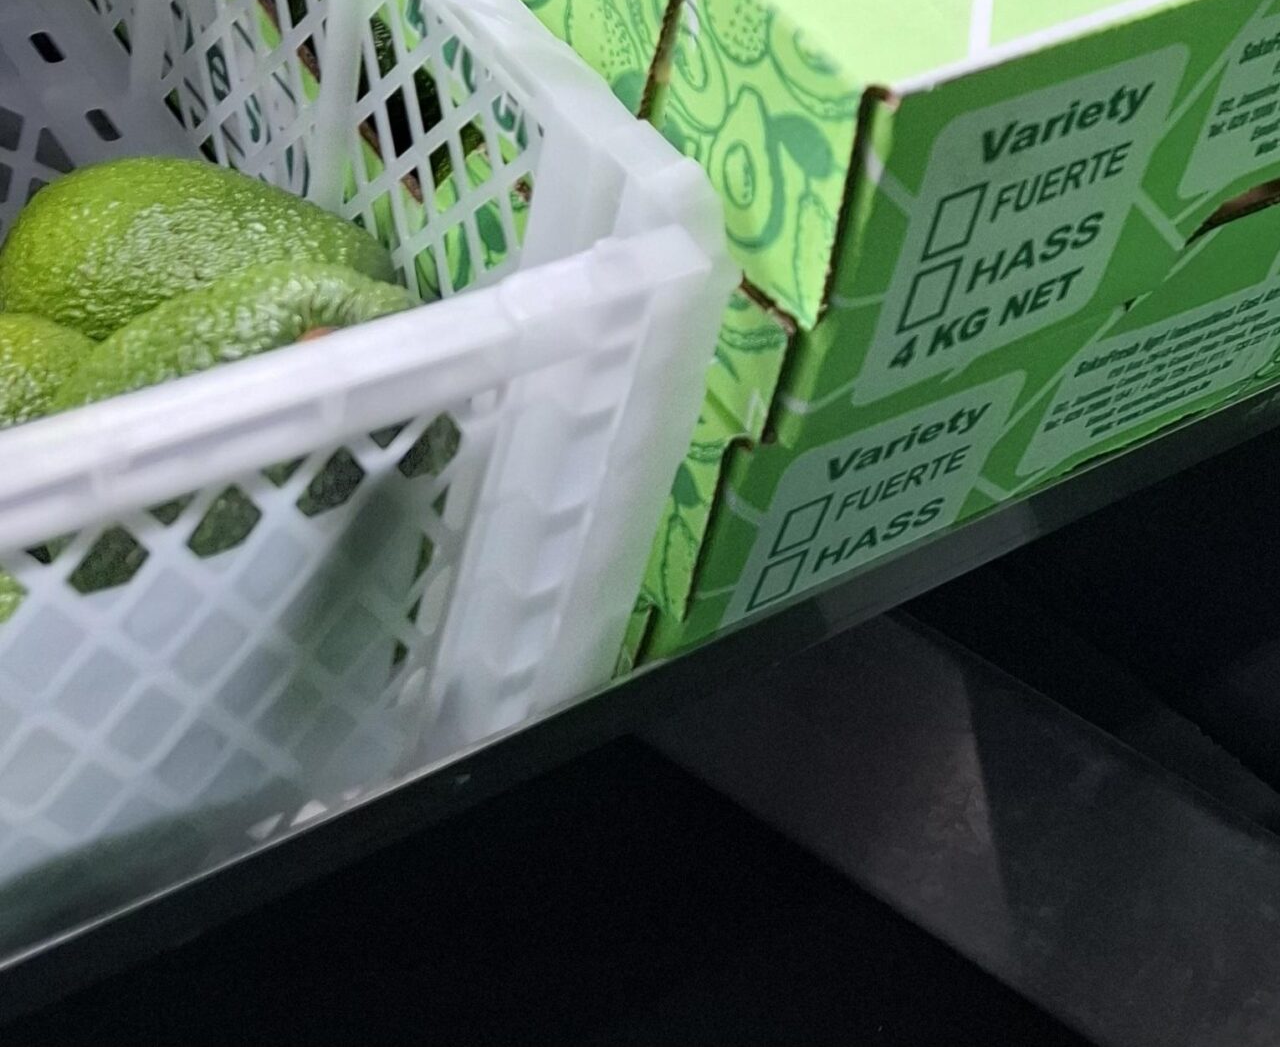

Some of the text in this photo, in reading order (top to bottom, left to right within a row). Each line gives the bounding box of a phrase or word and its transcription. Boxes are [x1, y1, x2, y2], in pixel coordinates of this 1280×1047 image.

[983, 81, 1155, 163] Variety
[990, 141, 1133, 223] FUERTE
[965, 211, 1105, 294] HASS
[888, 266, 1084, 369] 4 KG NET
[828, 402, 992, 481] Variety
[835, 444, 972, 521] FUERTE
[812, 497, 945, 574] HASS
